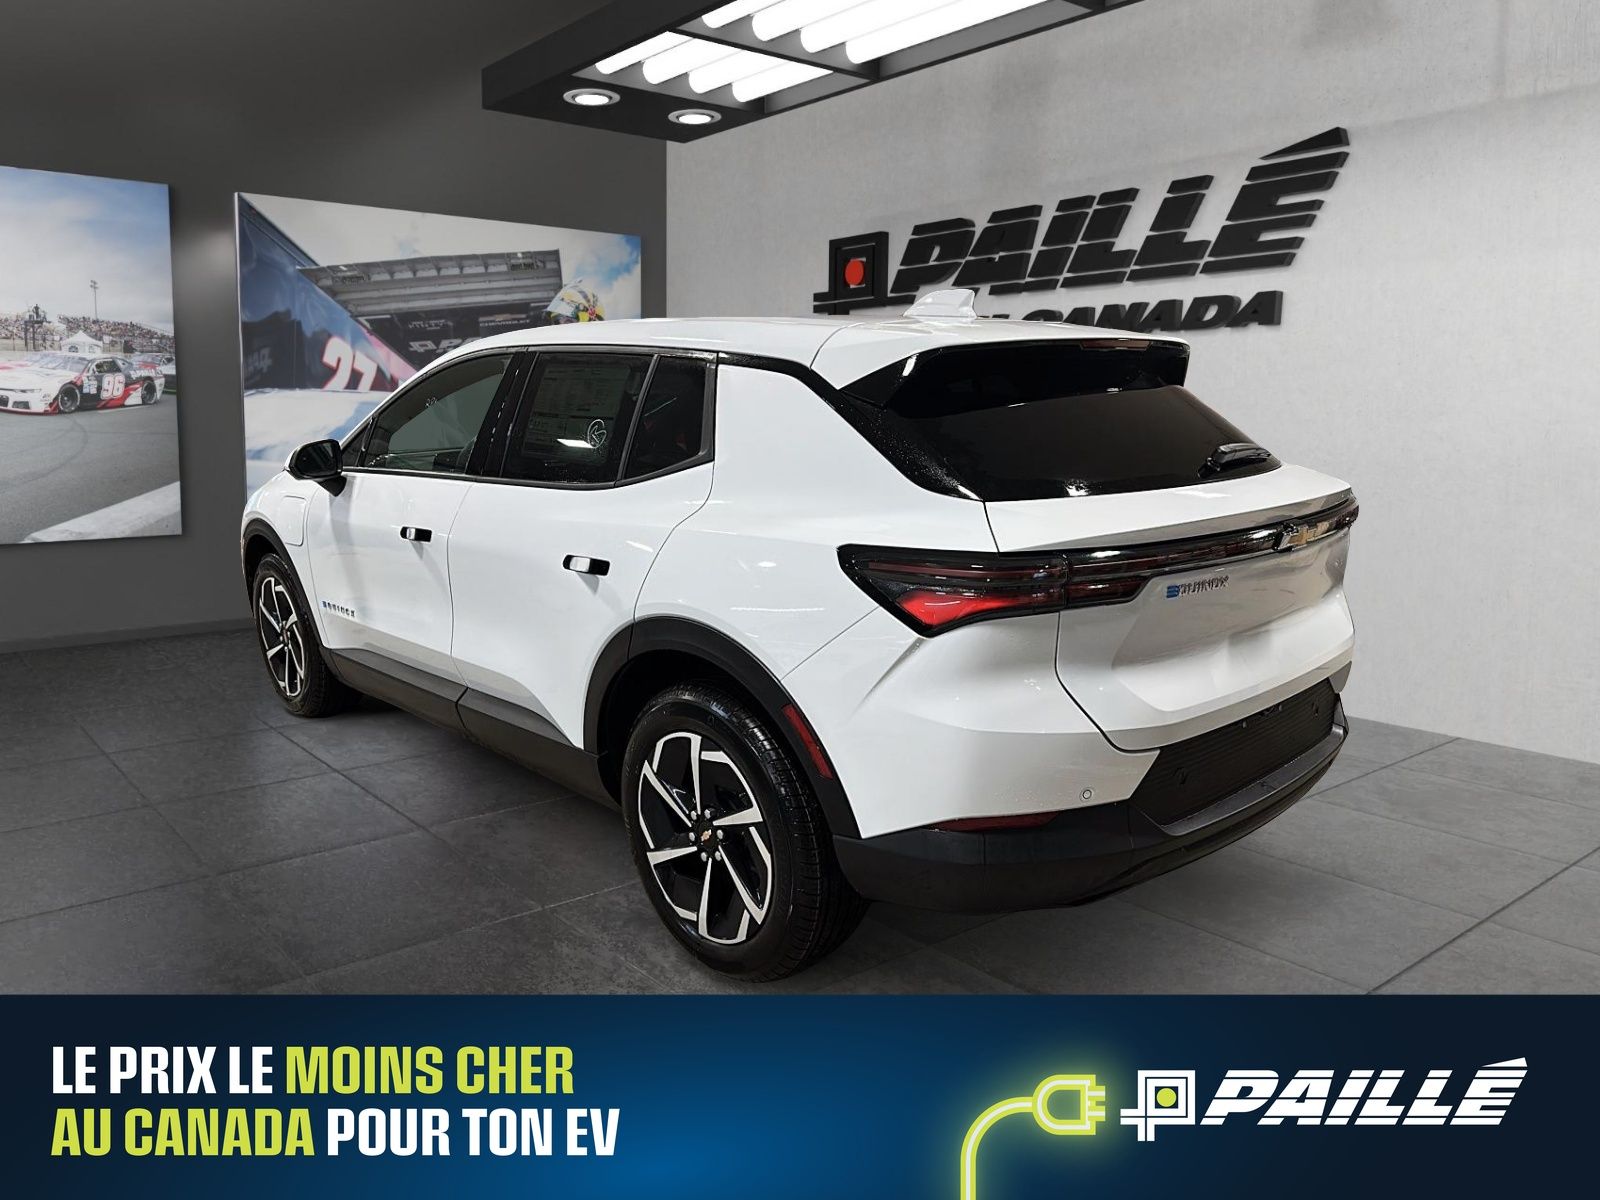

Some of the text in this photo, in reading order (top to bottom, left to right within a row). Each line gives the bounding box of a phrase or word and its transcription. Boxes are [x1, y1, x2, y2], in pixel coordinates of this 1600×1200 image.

[890, 126, 1350, 297] PAILLÉ
[101, 373, 126, 400] 96
[322, 335, 379, 392] 27
